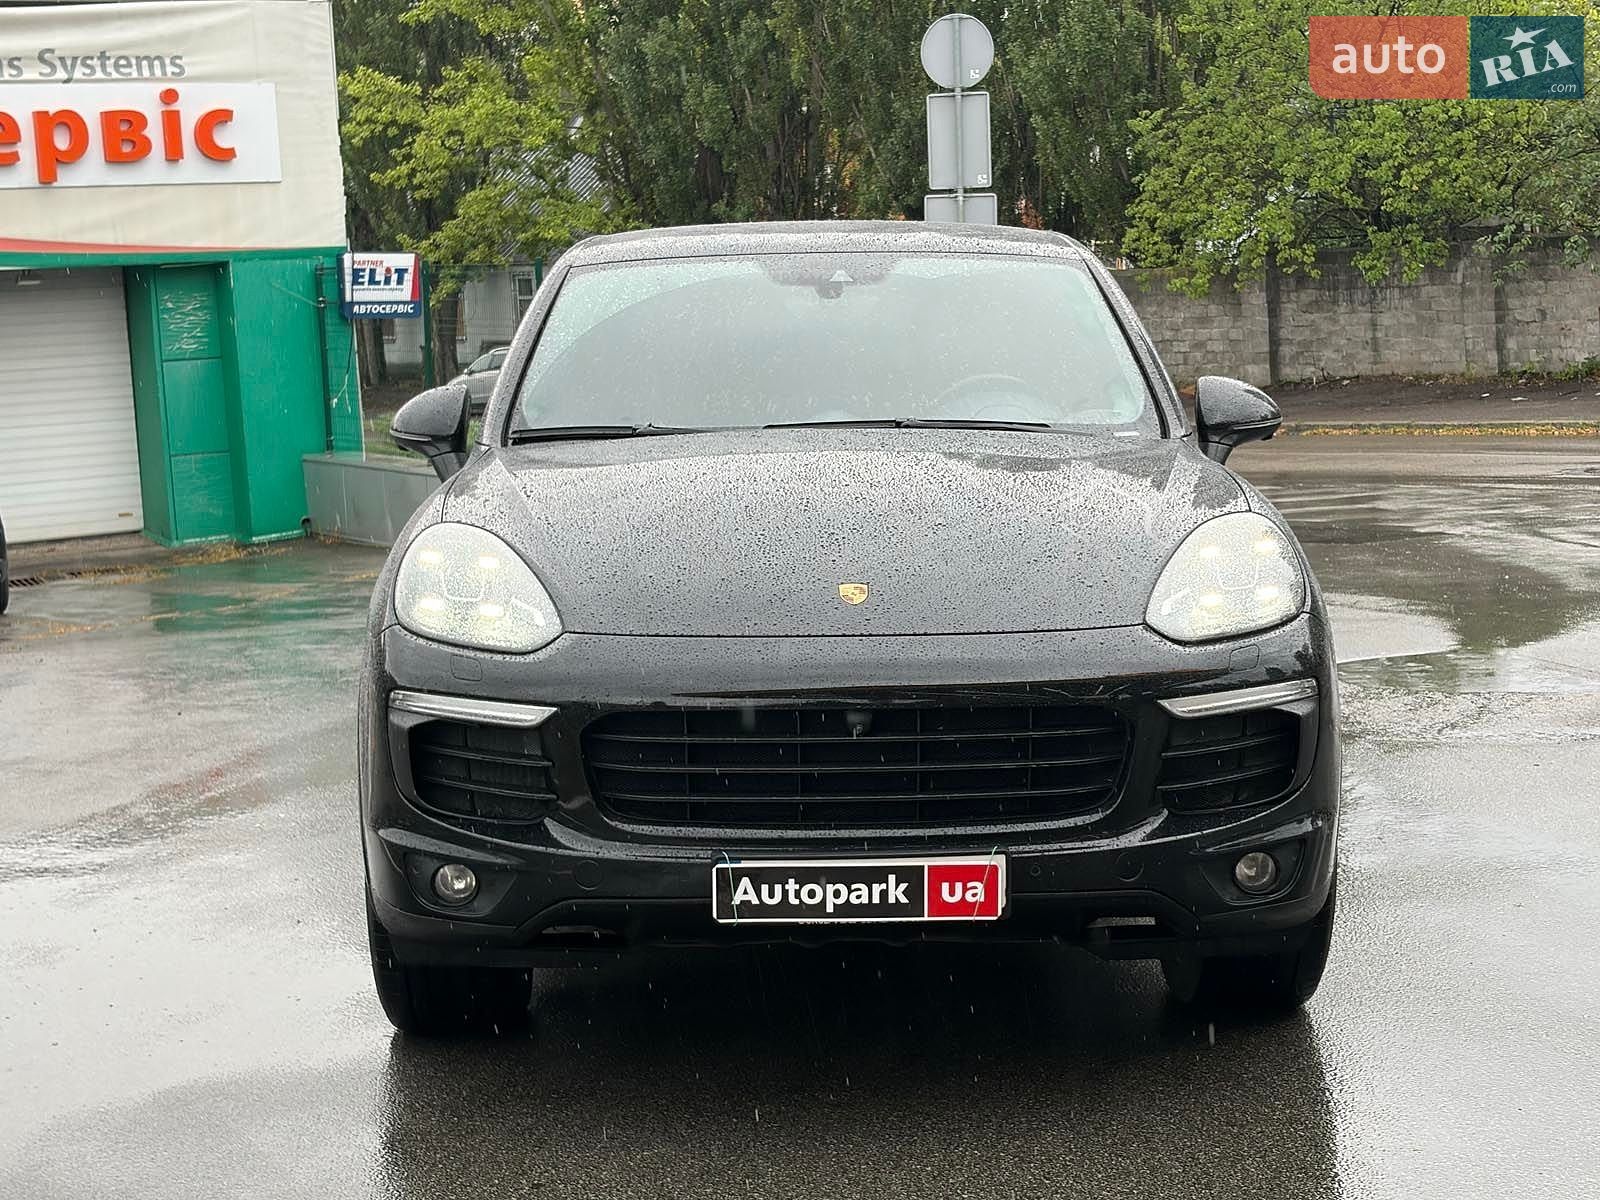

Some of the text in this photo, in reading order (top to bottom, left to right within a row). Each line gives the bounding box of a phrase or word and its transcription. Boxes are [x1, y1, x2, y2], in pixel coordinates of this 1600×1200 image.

[0, 48, 186, 84] s Systems
[353, 304, 415, 314] АВТОСЕРВІС
[731, 873, 985, 913] Autopark ua
